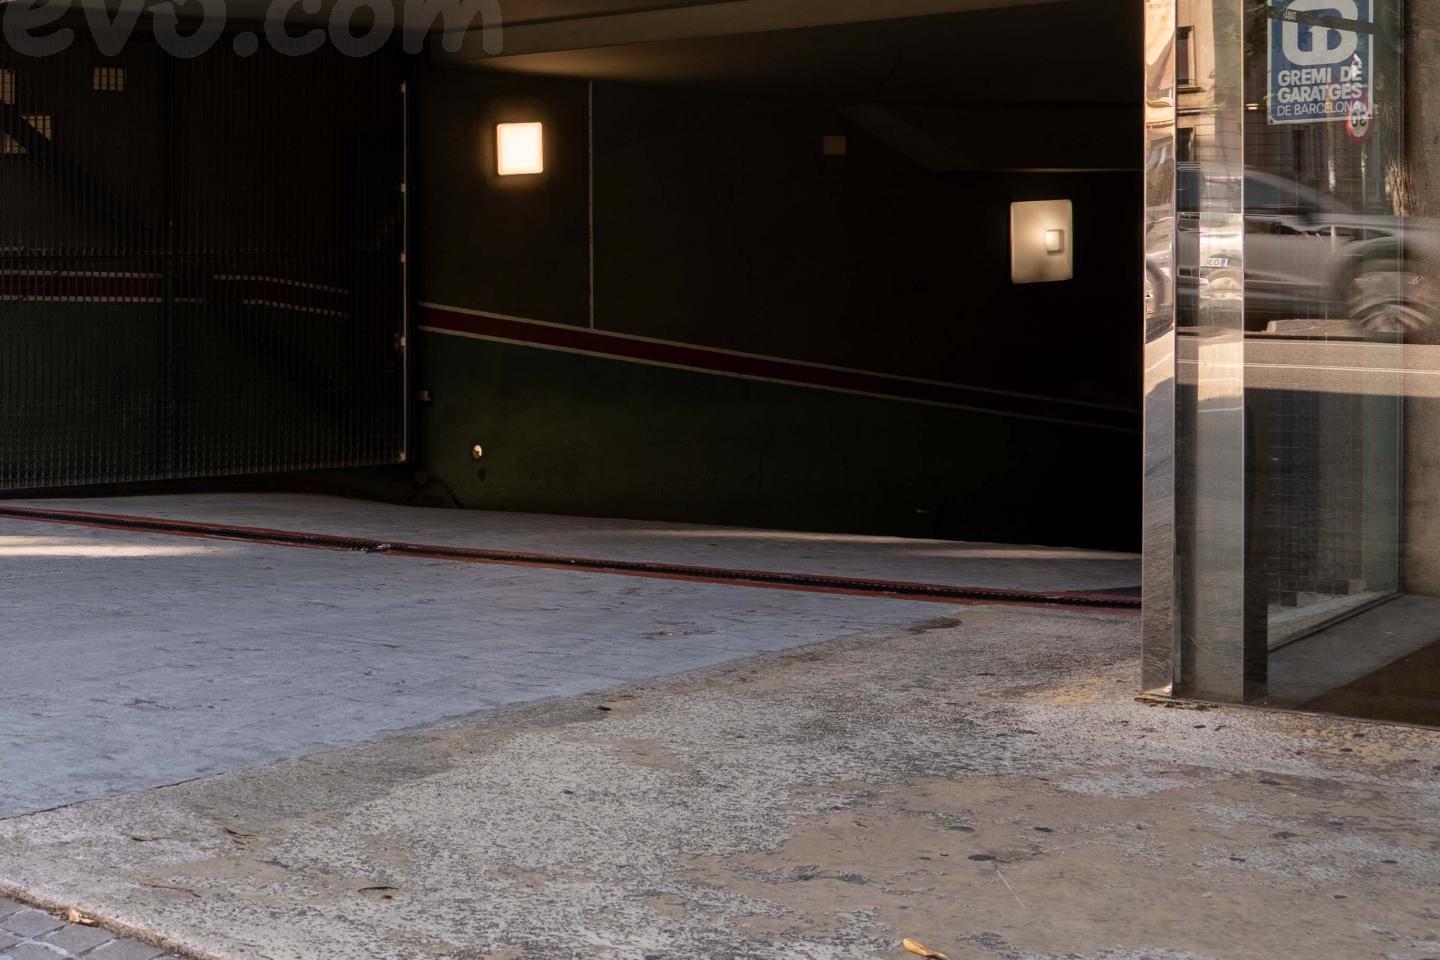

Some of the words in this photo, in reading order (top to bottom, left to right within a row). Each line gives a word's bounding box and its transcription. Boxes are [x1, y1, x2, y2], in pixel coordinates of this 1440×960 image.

[1277, 67, 1332, 86] GREMI
[1340, 64, 1362, 82] DE
[1277, 84, 1363, 103] GARATGES
[1277, 105, 1292, 116] DE
[1294, 100, 1361, 115] BARCELONA
